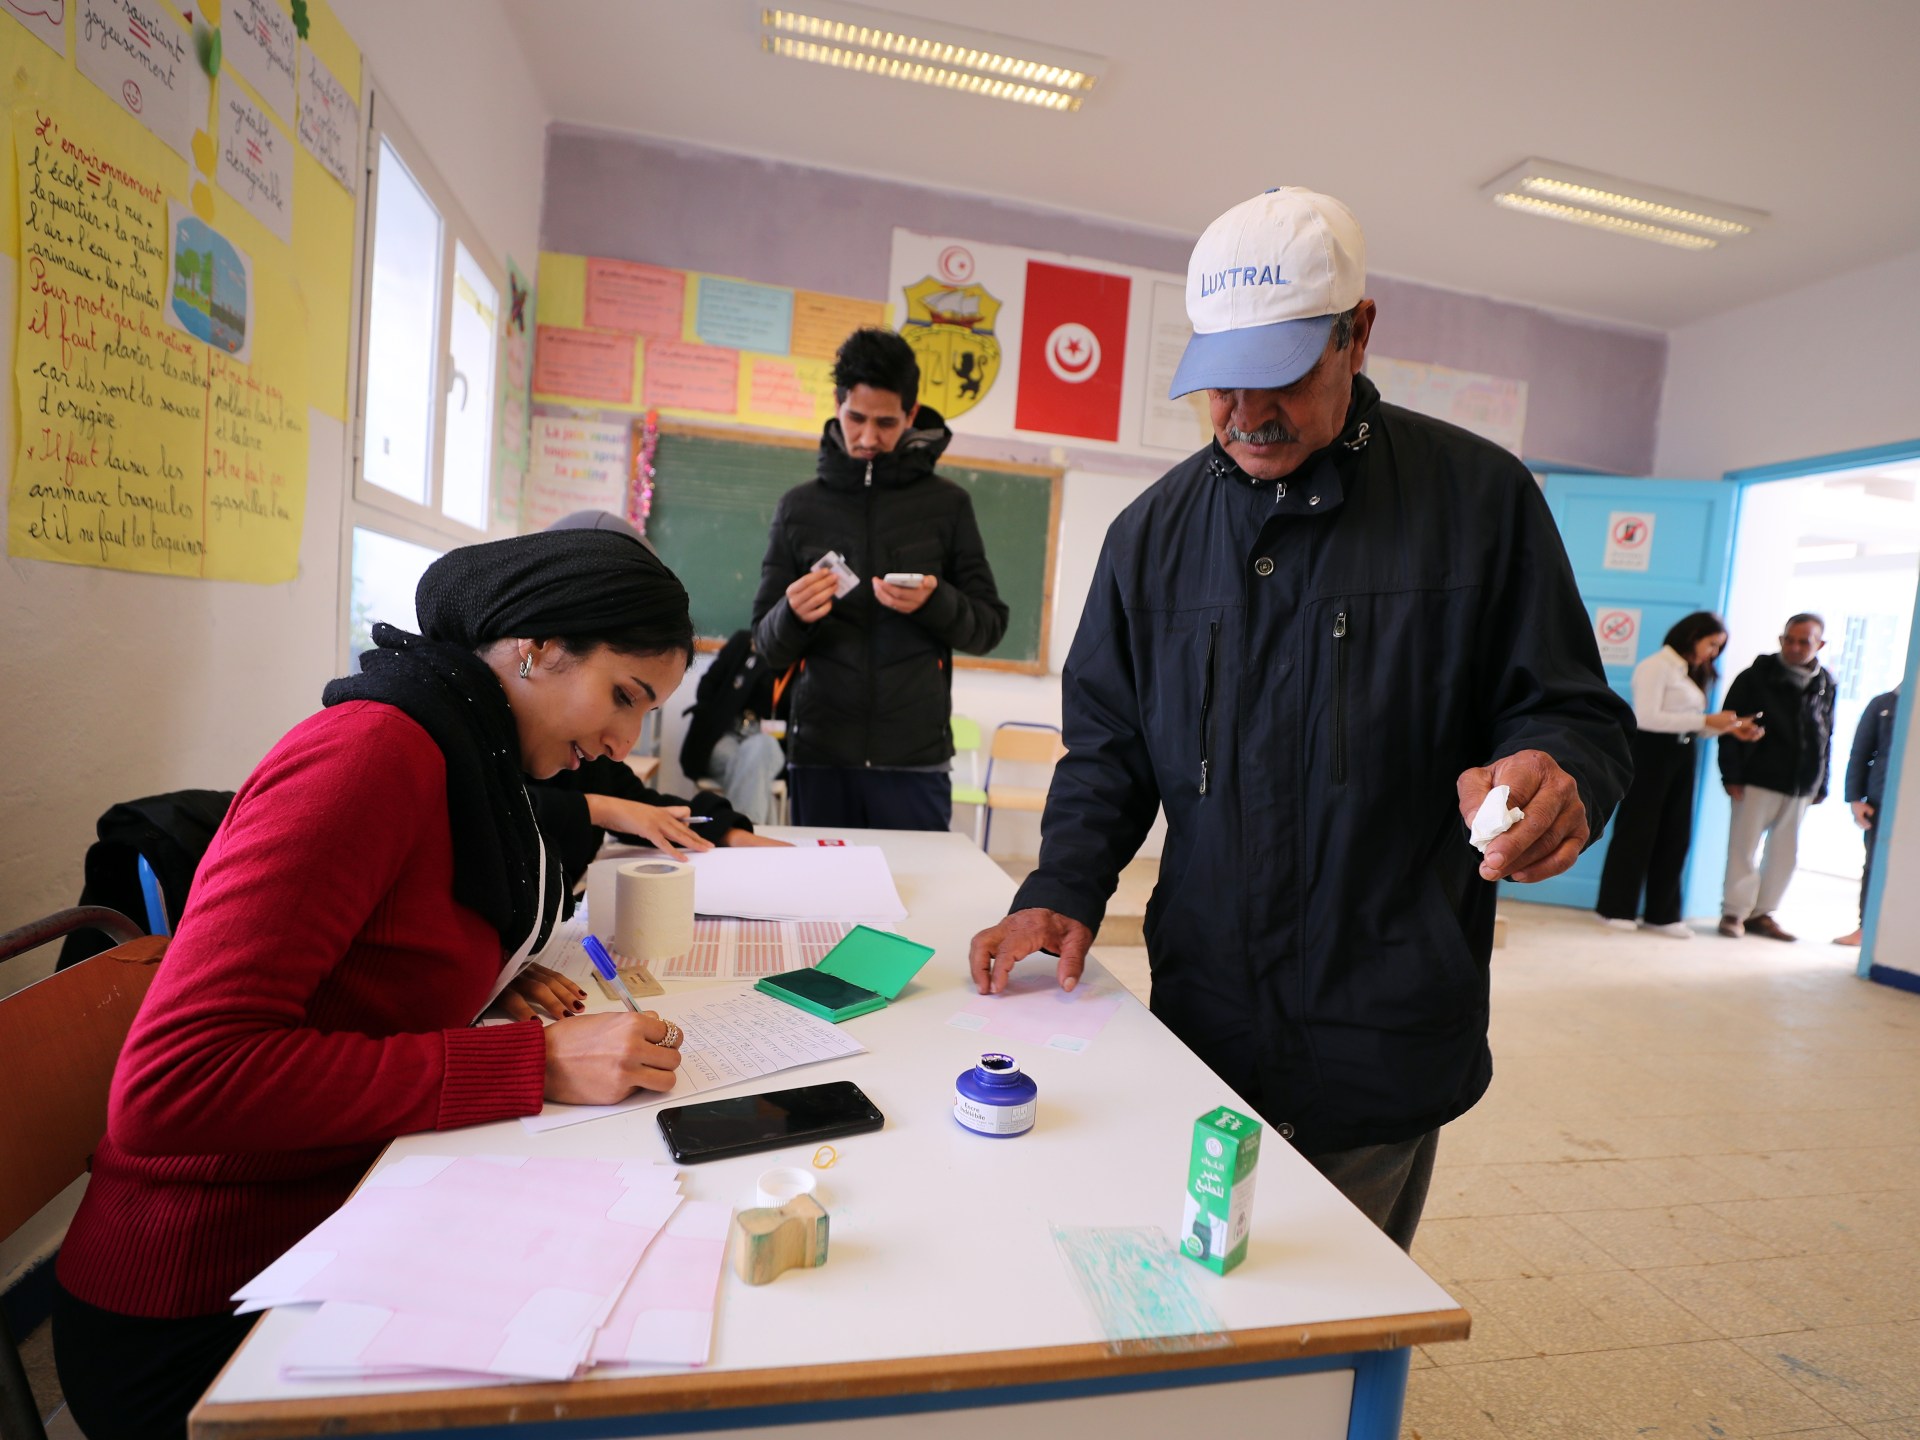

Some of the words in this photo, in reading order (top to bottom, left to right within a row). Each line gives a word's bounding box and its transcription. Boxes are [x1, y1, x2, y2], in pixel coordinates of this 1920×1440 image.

[84, 1, 176, 91] joyeusement
[122, 1, 185, 63] souriant
[29, 255, 71, 305] Pour
[1201, 265, 1286, 298] LUXTRAL
[27, 299, 50, 340] il
[59, 303, 98, 372] faut
[28, 476, 112, 508] animaux
